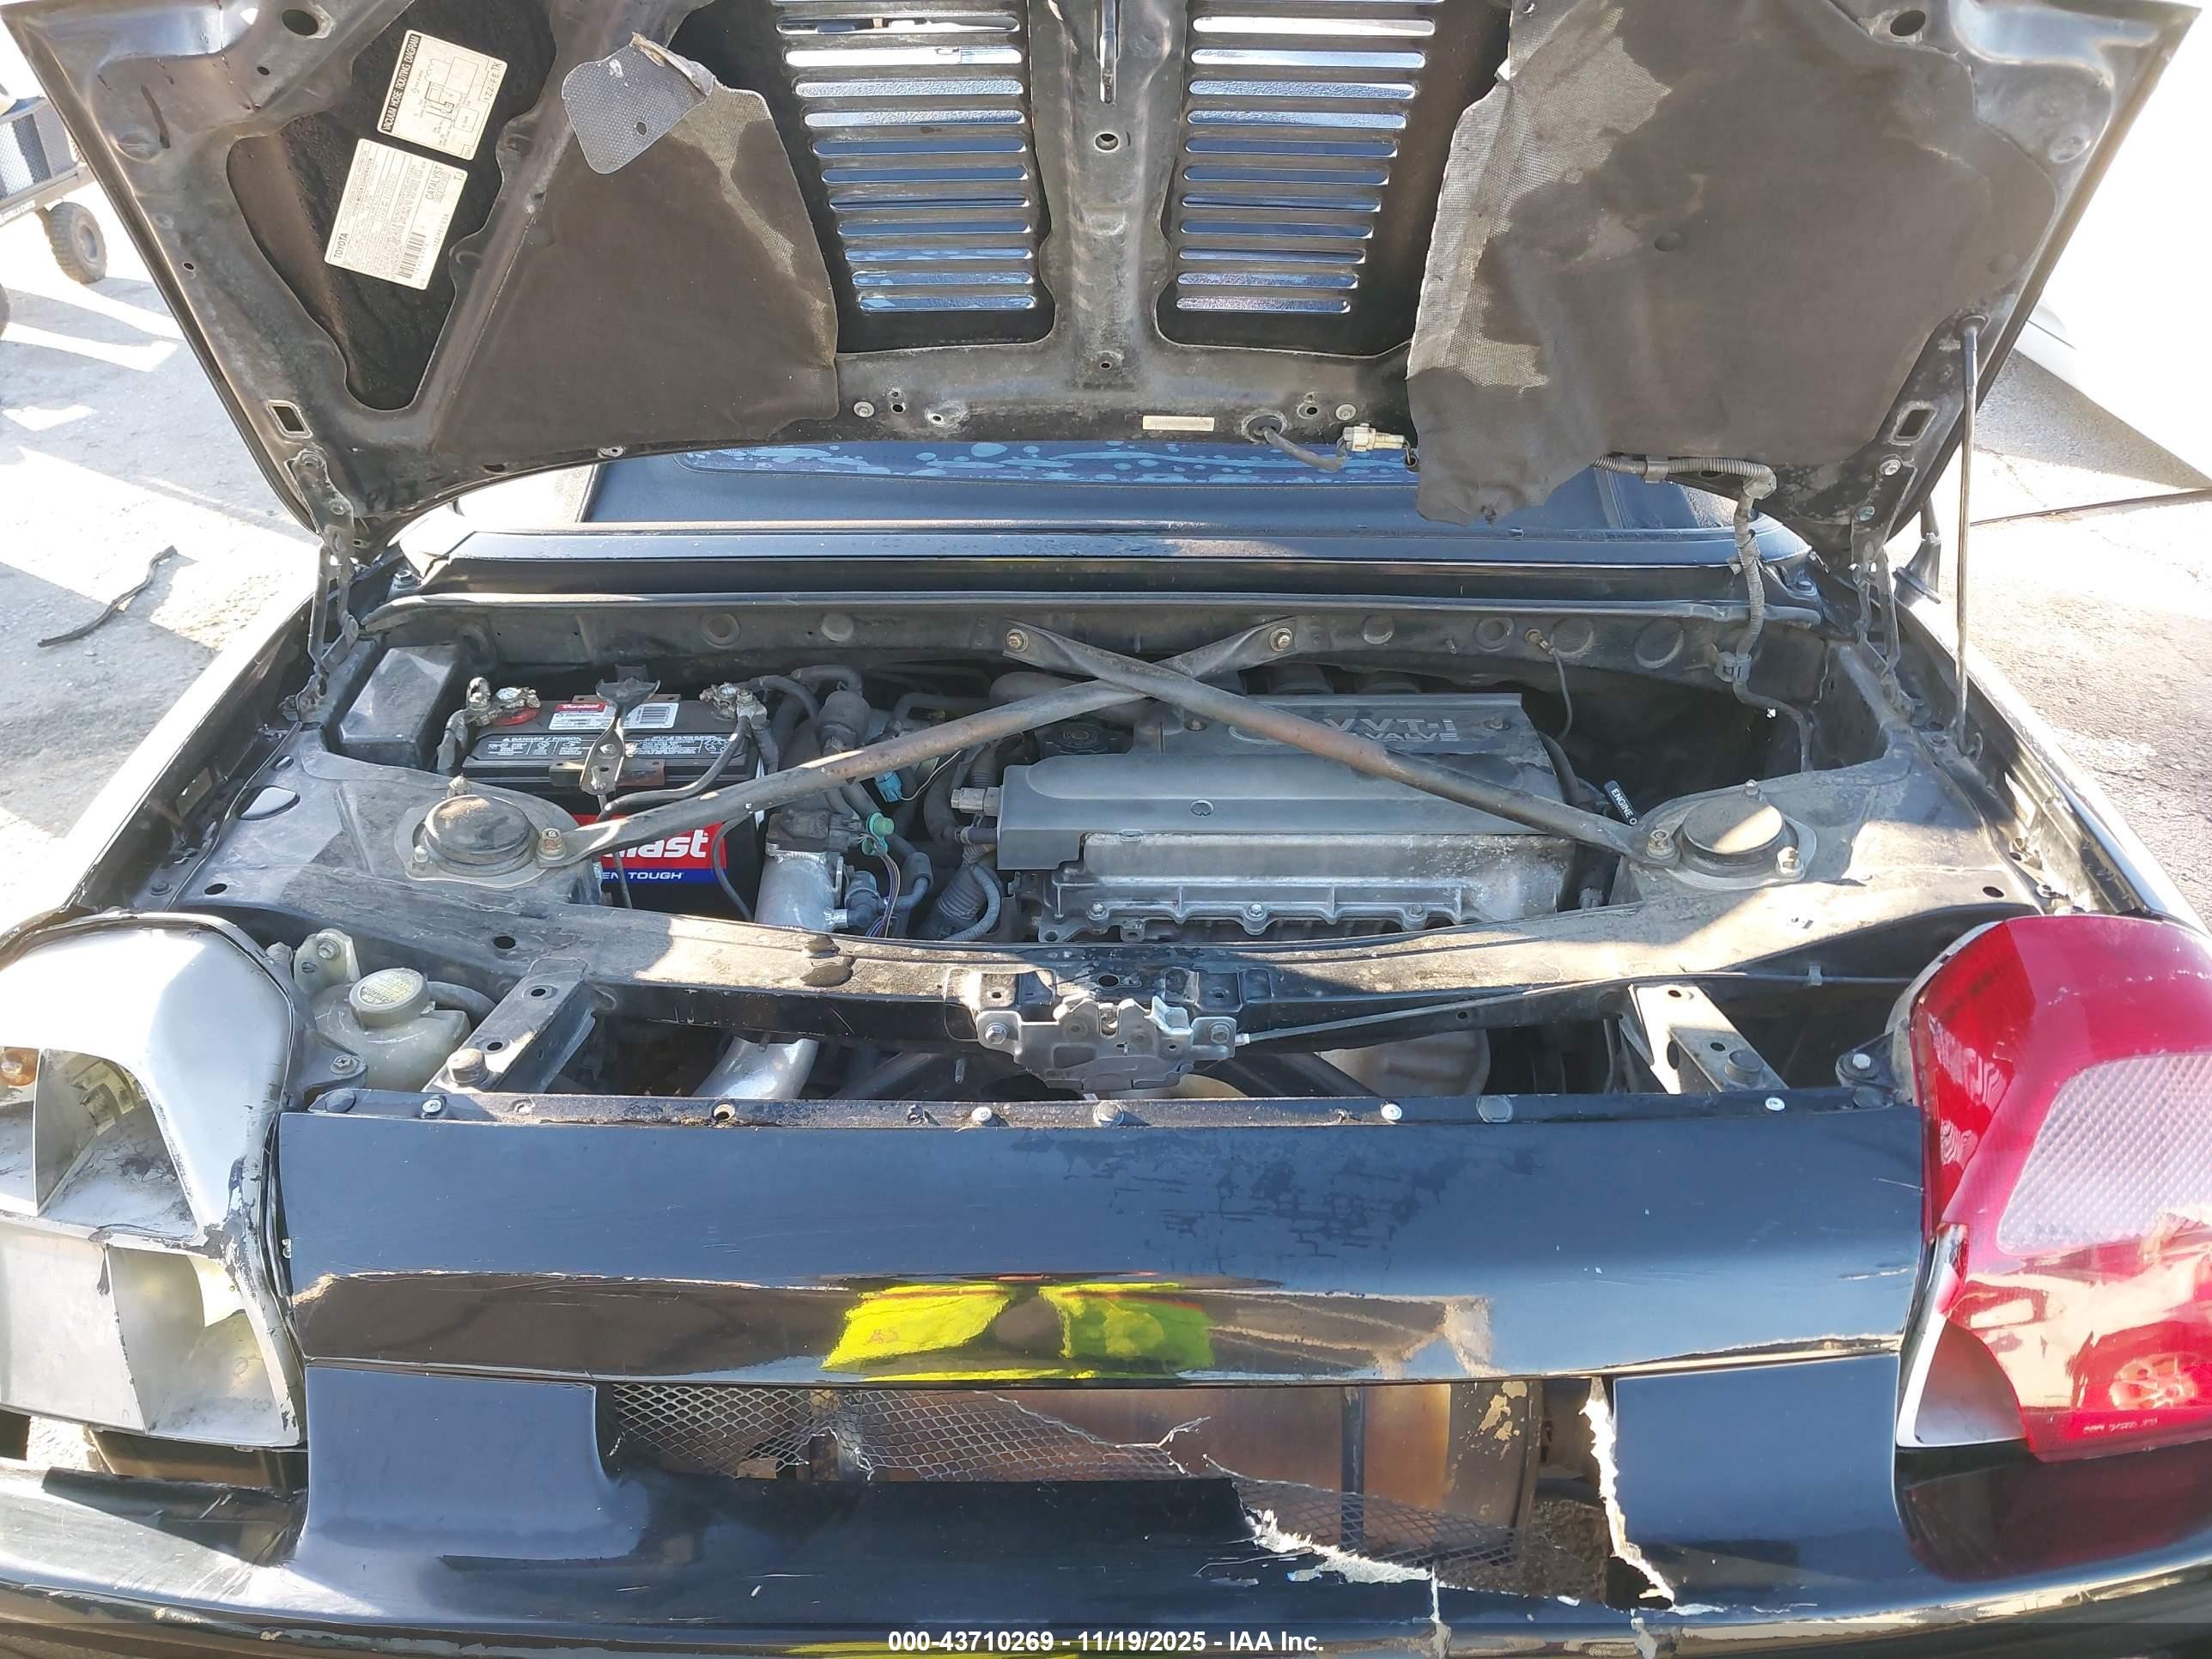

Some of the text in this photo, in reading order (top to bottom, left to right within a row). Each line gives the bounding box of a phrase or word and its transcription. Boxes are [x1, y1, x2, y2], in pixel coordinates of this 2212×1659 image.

[404, 35, 419, 63] DIAGRAM
[395, 63, 410, 89] ROUTING
[390, 90, 402, 107] HOSE
[382, 106, 398, 131] VACUUM
[425, 165, 444, 201] CATALYST
[333, 232, 349, 259] TOYOTA
[1323, 718, 1457, 732] VVT-i
[1365, 732, 1461, 742] VALVE
[1611, 788, 1638, 825] ENGINE O
